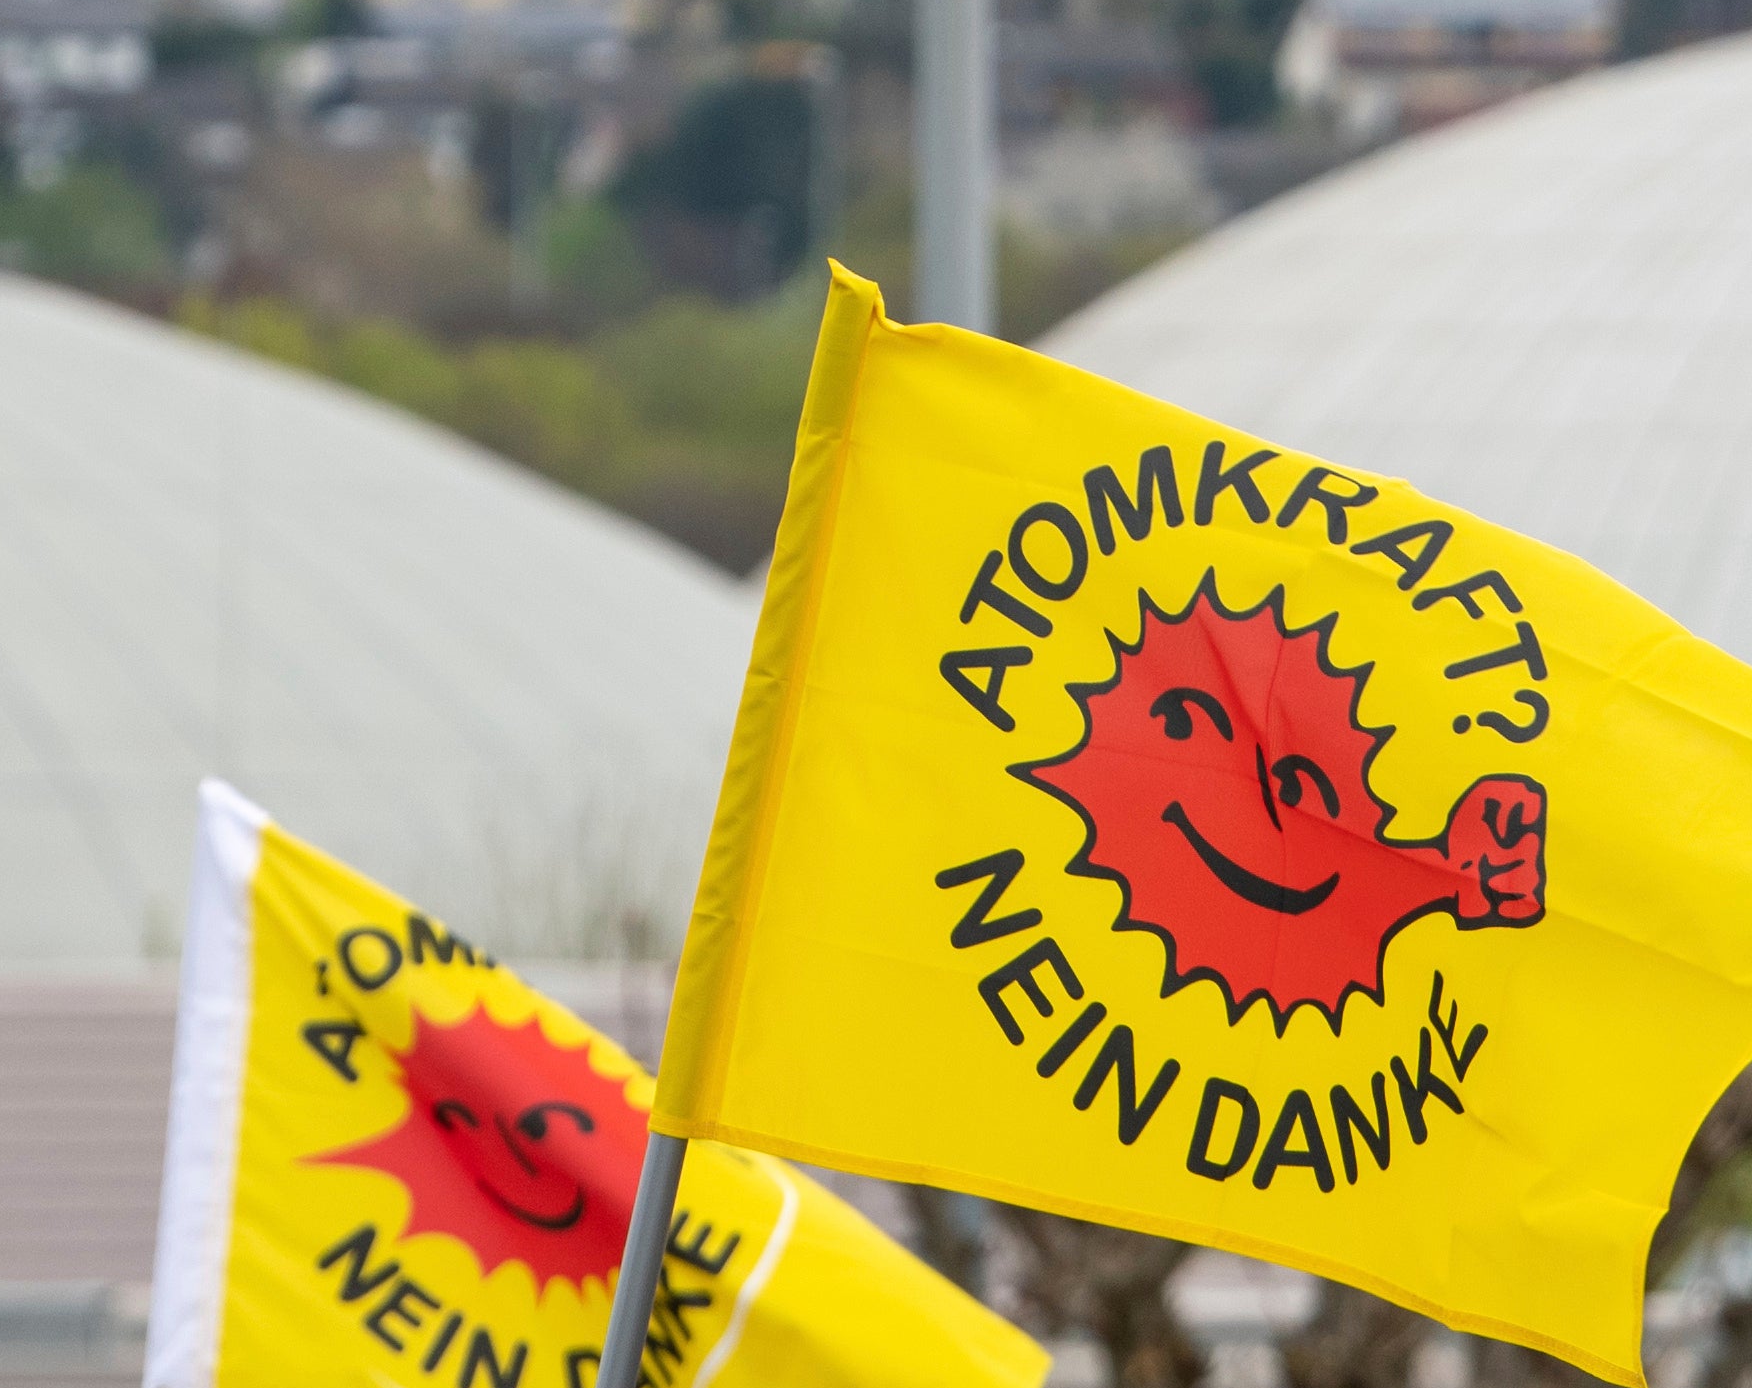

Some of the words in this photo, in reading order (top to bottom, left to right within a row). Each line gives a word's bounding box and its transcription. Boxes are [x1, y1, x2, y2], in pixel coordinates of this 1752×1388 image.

[938, 440, 1550, 744] ATOMKRAFT?
[940, 847, 1182, 1147] NEIN
[1188, 969, 1490, 1194] DANKE
